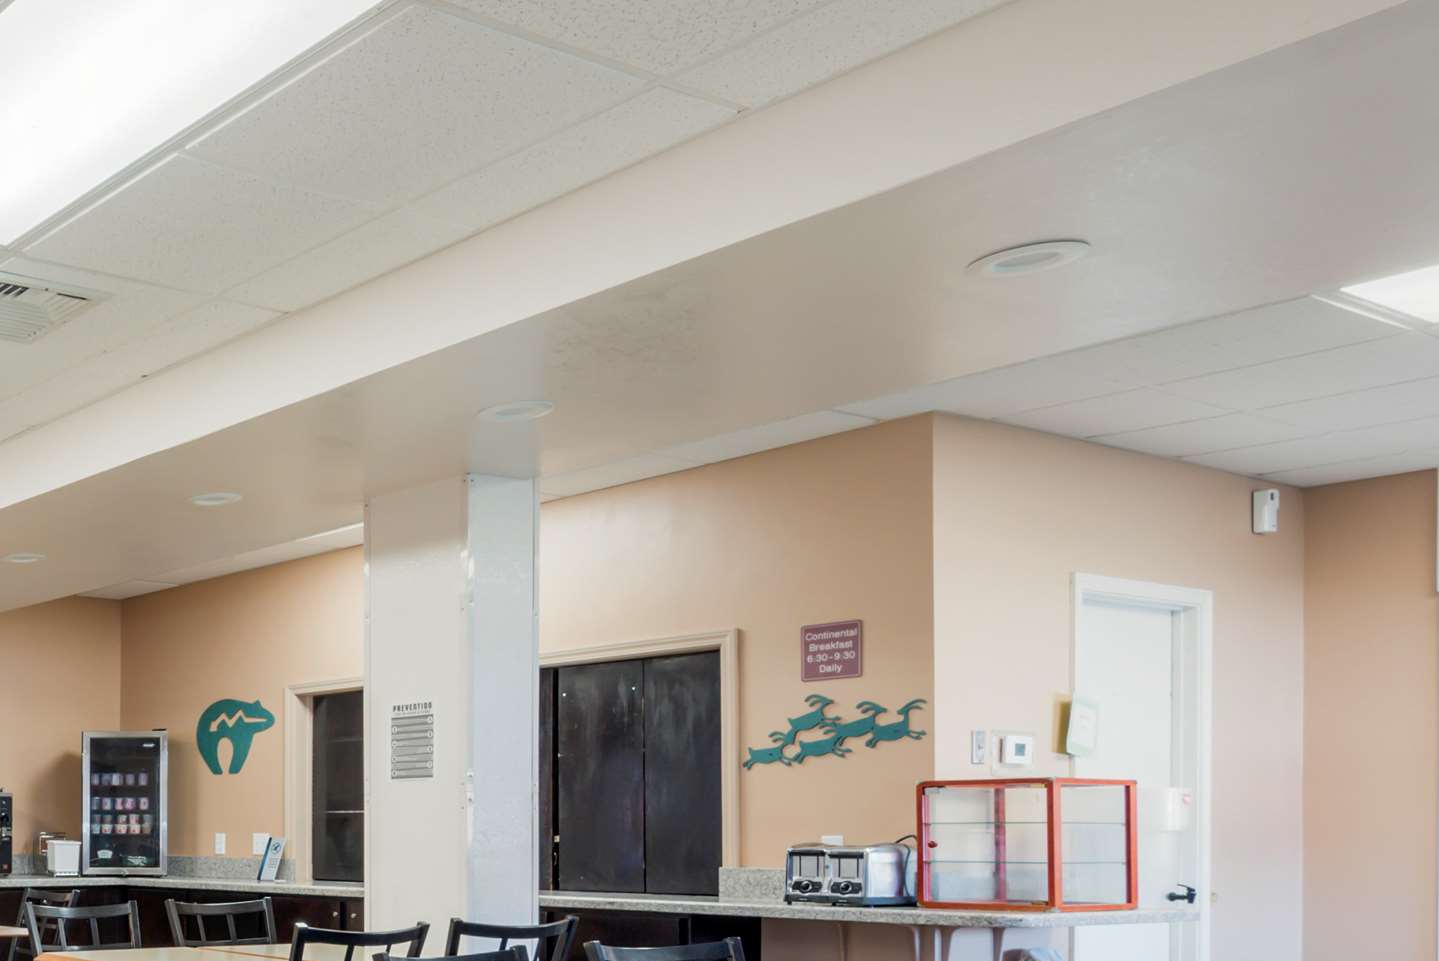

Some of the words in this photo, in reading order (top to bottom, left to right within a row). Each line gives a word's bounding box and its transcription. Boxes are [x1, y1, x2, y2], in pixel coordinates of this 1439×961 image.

[805, 628, 858, 641] Continental
[808, 640, 853, 652] Breakfast
[819, 664, 842, 673] Daily
